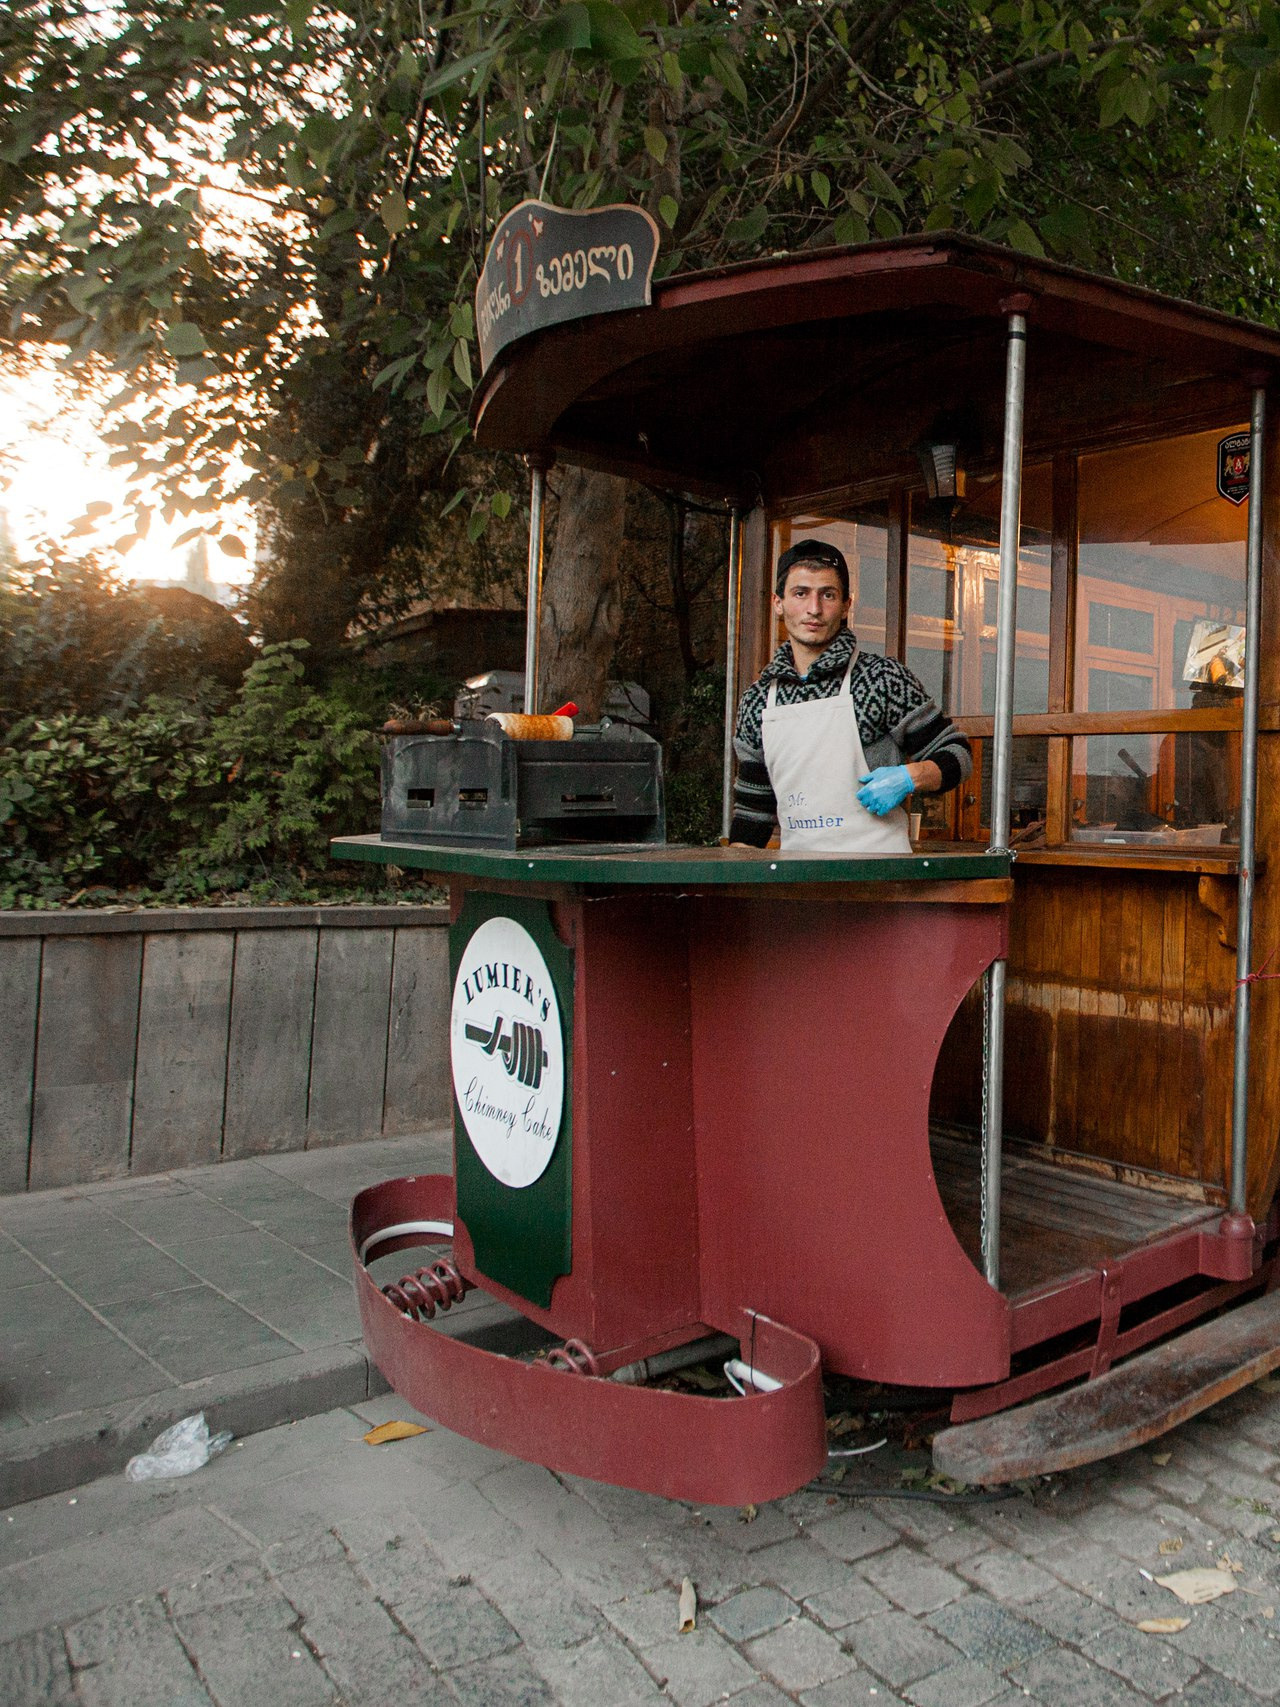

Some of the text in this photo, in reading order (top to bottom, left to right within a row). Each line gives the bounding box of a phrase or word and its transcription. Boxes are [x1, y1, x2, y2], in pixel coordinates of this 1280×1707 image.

[514, 242, 523, 294] 1
[535, 243, 634, 298] ზემელი
[787, 816, 844, 829] Lumier
[788, 792, 807, 807] Mr.
[462, 962, 551, 1023] LUMIER'S
[464, 1076, 553, 1141] Chimney Cake
